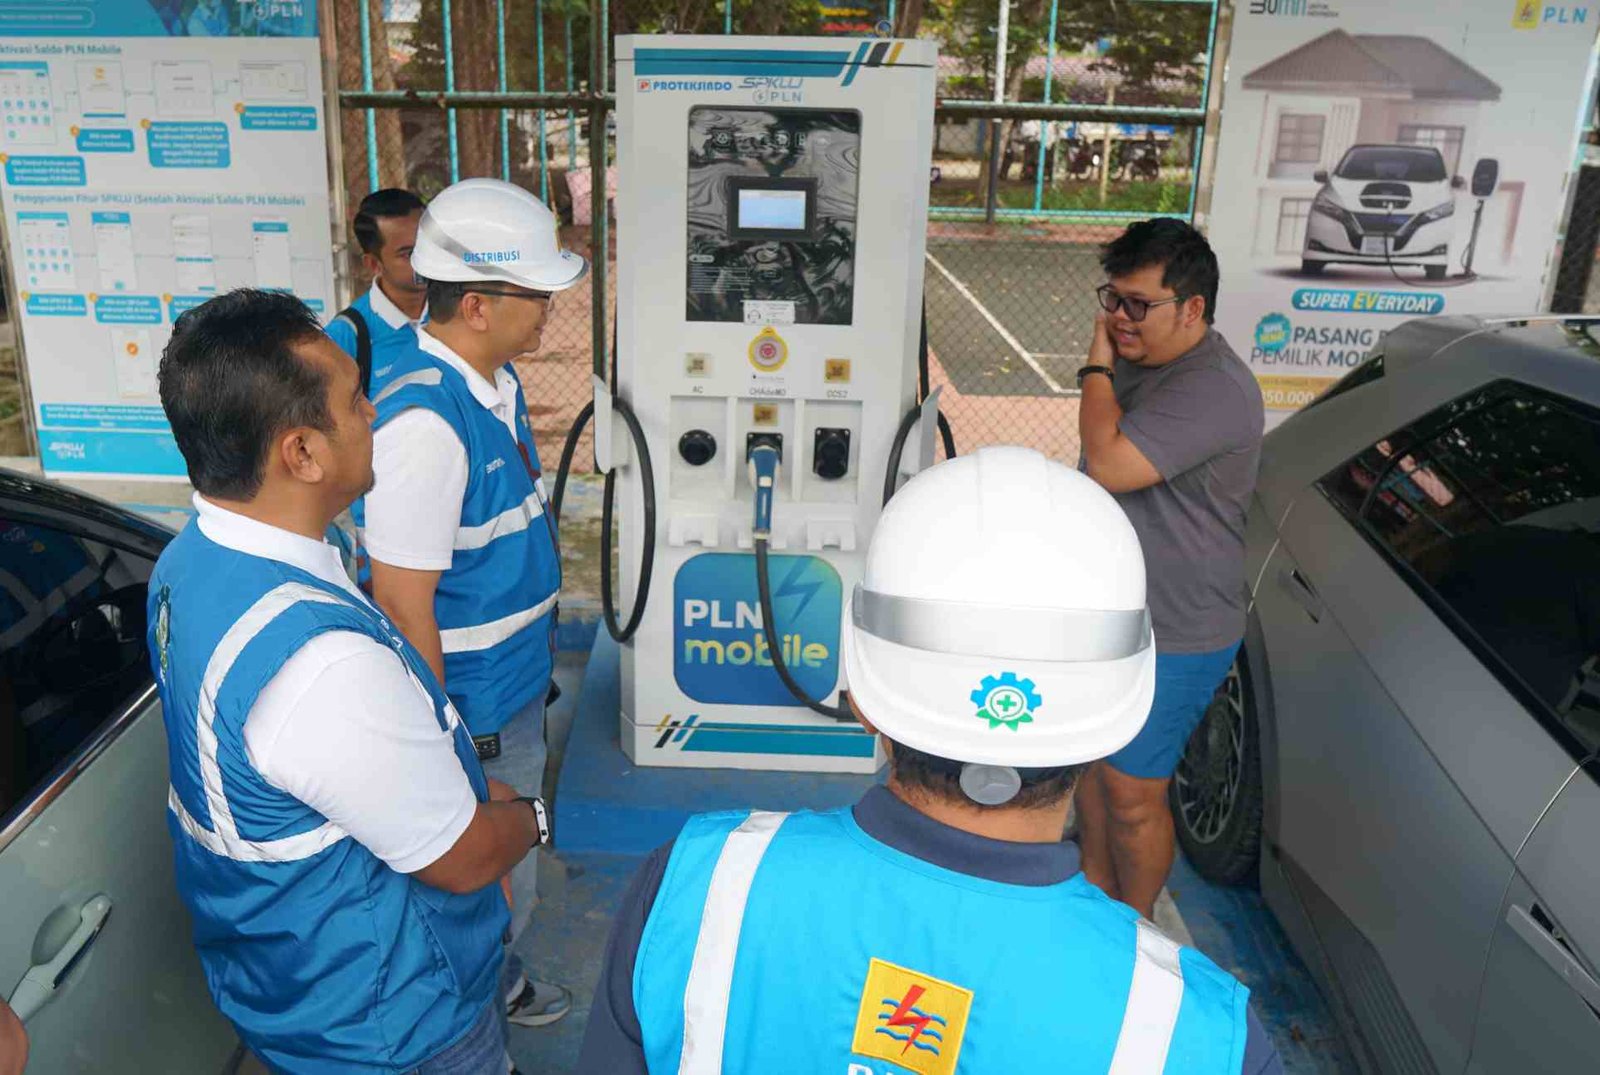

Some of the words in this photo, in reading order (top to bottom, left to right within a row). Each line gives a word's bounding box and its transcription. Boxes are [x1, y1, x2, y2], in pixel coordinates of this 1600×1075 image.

[1543, 6, 1587, 23] PLN
[65, 44, 84, 54] PLN
[87, 44, 121, 54] Mobile
[770, 91, 802, 102] PLN
[463, 250, 520, 262] DISTRIBUSI
[1300, 291, 1350, 309] SUPER
[1352, 291, 1437, 312] EVERYDAY
[1293, 326, 1373, 346] PASANG
[1250, 346, 1324, 366] PEMILIK
[692, 386, 704, 394] AC
[684, 599, 763, 629] PLN
[684, 634, 829, 668] mobile
